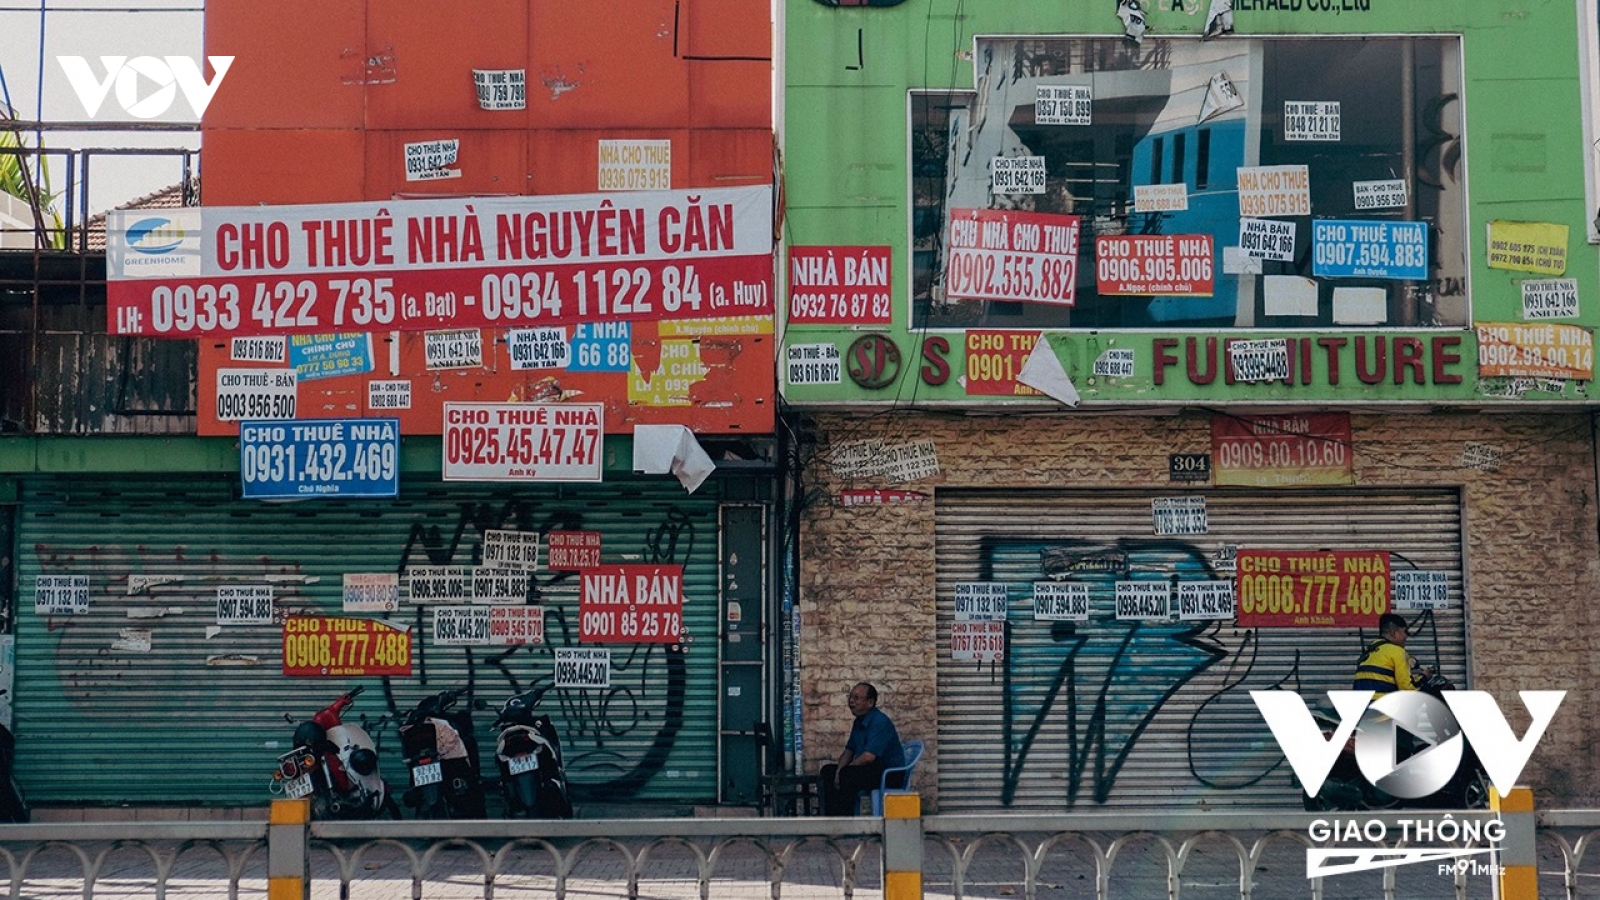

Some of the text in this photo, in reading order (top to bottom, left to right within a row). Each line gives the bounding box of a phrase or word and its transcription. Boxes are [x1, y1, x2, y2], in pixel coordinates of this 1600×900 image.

[1286, 116, 1339, 132] 0848 21 21 12
[600, 141, 670, 164] NHÀ CHO THUÊ
[995, 157, 1042, 169] CHO THUÊ NHÀ
[600, 169, 669, 188] 0936 075 915
[995, 171, 1044, 186] 0931 642 166
[1240, 166, 1307, 191] NHÀ CHO THUÊ
[1240, 194, 1308, 215] 0936 075 915
[1356, 194, 1405, 207] 0903 956 500
[216, 195, 734, 270] CHO THUÊ NHÀ NGUYÊN CĂN
[951, 211, 1078, 253] CHỦ NHÀ CHO THUÊ
[1246, 221, 1289, 234] NHÀ BÁN
[1317, 224, 1423, 243] CHO THUÊ NHÀ
[1099, 235, 1210, 257] CHO THUÊ NHÀ
[1241, 232, 1293, 253] 0931 642 166
[125, 257, 185, 265] GREENHOME
[1317, 242, 1424, 267] 0907.594.883
[792, 250, 887, 286] NHÀ BÁN
[951, 252, 1073, 300] 0902.555.882
[1099, 258, 1211, 282] 0906.905.006
[1148, 283, 1173, 293] (chính
[117, 307, 142, 334] LH:
[151, 284, 239, 332] 0933
[252, 281, 318, 328] 422
[328, 278, 395, 325] 735
[401, 294, 420, 319] (a.
[425, 291, 456, 322] Đạt)
[481, 271, 561, 320] 0934
[572, 268, 652, 315] 1122
[662, 265, 701, 311] 84
[709, 284, 729, 309] (a.
[733, 280, 767, 307] Huy)
[791, 294, 889, 318] 0932 76 87 82
[1524, 291, 1576, 309] 0931 642 166
[517, 329, 560, 342] NHÀ BÁN
[233, 340, 283, 360] 093 616 8612
[427, 340, 480, 359] 0931 642 166
[513, 341, 565, 360] 0931 642 166
[579, 343, 629, 366] 66 88
[1153, 335, 1463, 385] FUITURE
[221, 375, 242, 387] CHO
[244, 373, 268, 386] THUÊ
[275, 372, 295, 387] BÁN
[790, 363, 839, 382] 093 616 8612
[218, 394, 296, 418] 0903 956 500
[448, 407, 598, 425] CHO THUÊ NHÀ
[244, 422, 394, 442] CHO THUÊ NHÀ
[448, 427, 598, 465] 0925.45.47.47
[1220, 439, 1344, 468] 0909.00.10.60
[244, 443, 395, 482] 0931.432.469
[1174, 456, 1206, 471] 304
[485, 544, 536, 561] 0971 132 168
[1241, 556, 1281, 572] CHO
[1287, 554, 1337, 573] THUÊ
[1344, 554, 1385, 573] NHÀ
[412, 579, 462, 598] 0906.905.006
[474, 579, 525, 598] 0907.594.883
[585, 568, 678, 604] NHÀ BÁN
[1241, 575, 1387, 615] 0908.777.488
[1396, 586, 1447, 600] 0971 132 168
[36, 590, 88, 605] 0971 132 168
[955, 595, 1006, 612] 0971 132 168
[1035, 595, 1086, 614] 0907.594.883
[1118, 595, 1167, 616] 0936.445.201
[1181, 592, 1231, 614] 0931.432.469
[218, 599, 270, 618] 0907.594.883
[437, 619, 488, 640] 0936.445.201
[490, 620, 542, 636] 0909 545 670
[583, 611, 679, 636] 0901 85 25 78
[1295, 616, 1335, 625] Anh Khánh
[286, 633, 408, 667] 0908.777.488
[556, 662, 608, 684] 0936.445.201
